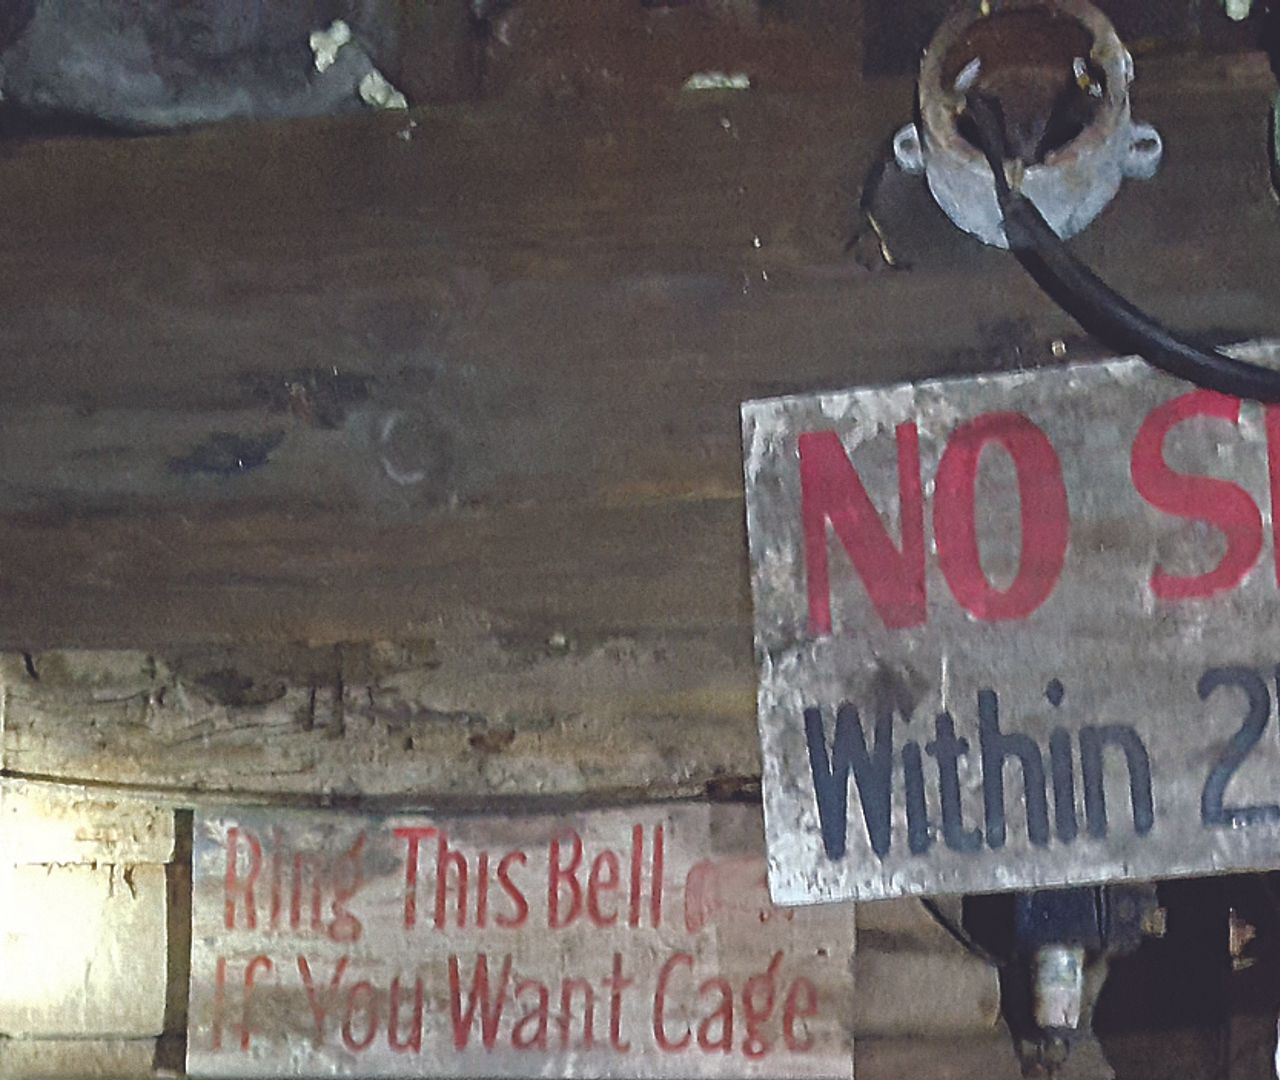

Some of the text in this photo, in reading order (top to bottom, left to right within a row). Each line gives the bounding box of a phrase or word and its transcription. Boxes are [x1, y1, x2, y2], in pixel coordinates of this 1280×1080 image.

[797, 412, 1070, 636] NO
[803, 677, 1155, 862] Within
[223, 822, 668, 945] Ring This Bell
[210, 948, 823, 1064] If You Want Cage
